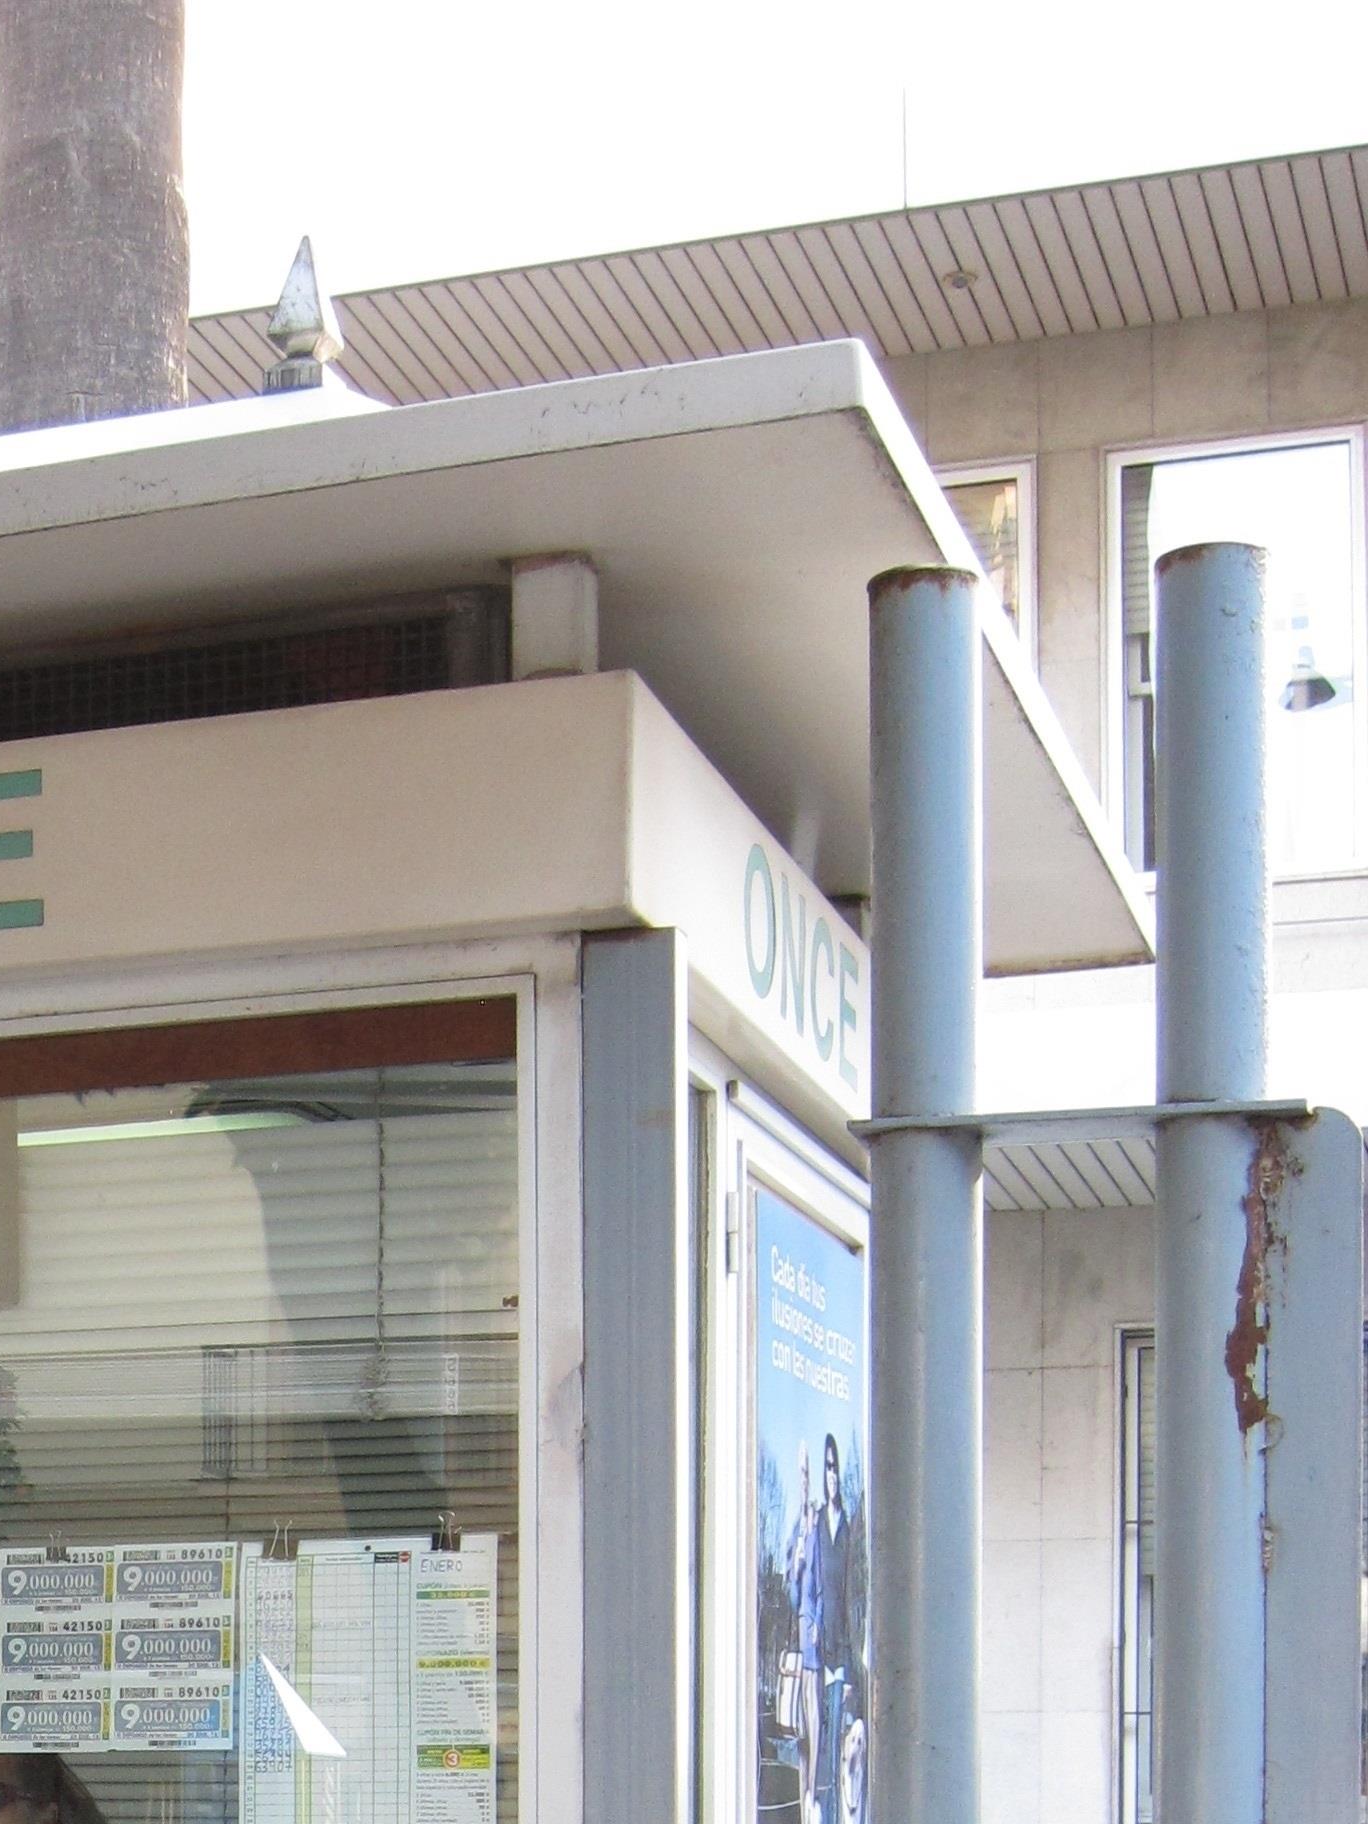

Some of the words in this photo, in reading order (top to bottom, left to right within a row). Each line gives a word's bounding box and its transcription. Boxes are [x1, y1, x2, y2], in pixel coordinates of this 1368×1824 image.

[744, 843, 858, 1094] ONCE
[771, 1245, 795, 1292] Cada
[772, 1339, 792, 1372] con
[420, 1558, 462, 1574] ENERO
[63, 1620, 103, 1631] 42150
[62, 1689, 101, 1700] 42150
